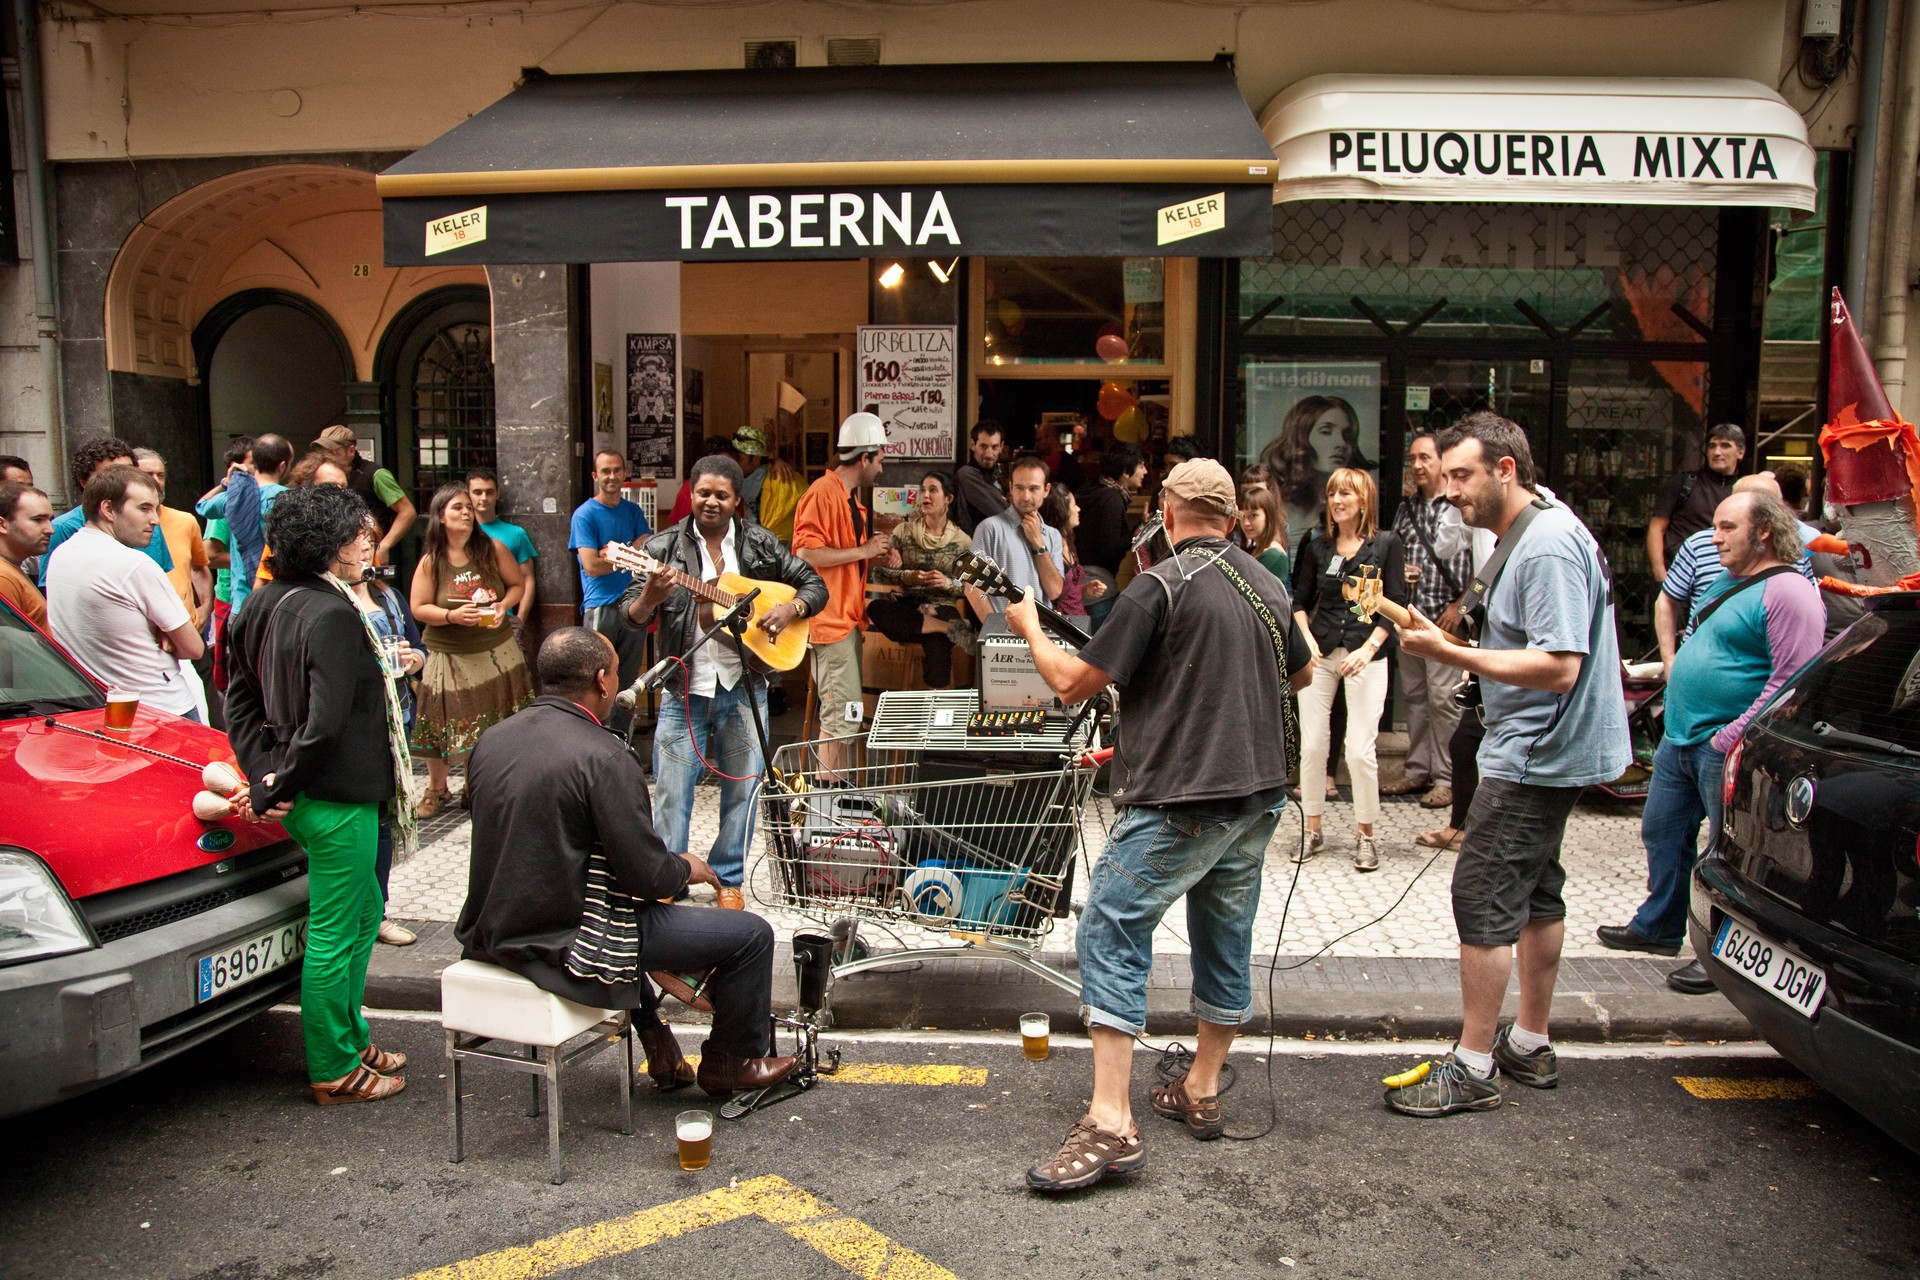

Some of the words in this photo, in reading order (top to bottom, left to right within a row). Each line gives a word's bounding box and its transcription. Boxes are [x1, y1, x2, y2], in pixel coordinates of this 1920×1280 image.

[1329, 131, 1606, 177] PELUQUERIA
[1633, 135, 1779, 180] MIXTA
[665, 190, 962, 250] TABERNA
[1165, 199, 1218, 224] KELER
[432, 212, 481, 236] KELER
[1188, 217, 1202, 229] 18
[453, 229, 466, 241] 18
[353, 264, 369, 277] 28
[630, 339, 672, 350] KAMPSA
[863, 331, 952, 353] URBELTZA
[1583, 406, 1646, 420] TREAT
[990, 652, 1014, 663] AER
[209, 833, 230, 846] Ford
[213, 934, 274, 989] 6967
[1725, 929, 1773, 978] 6498
[1773, 957, 1823, 1008] DGW
